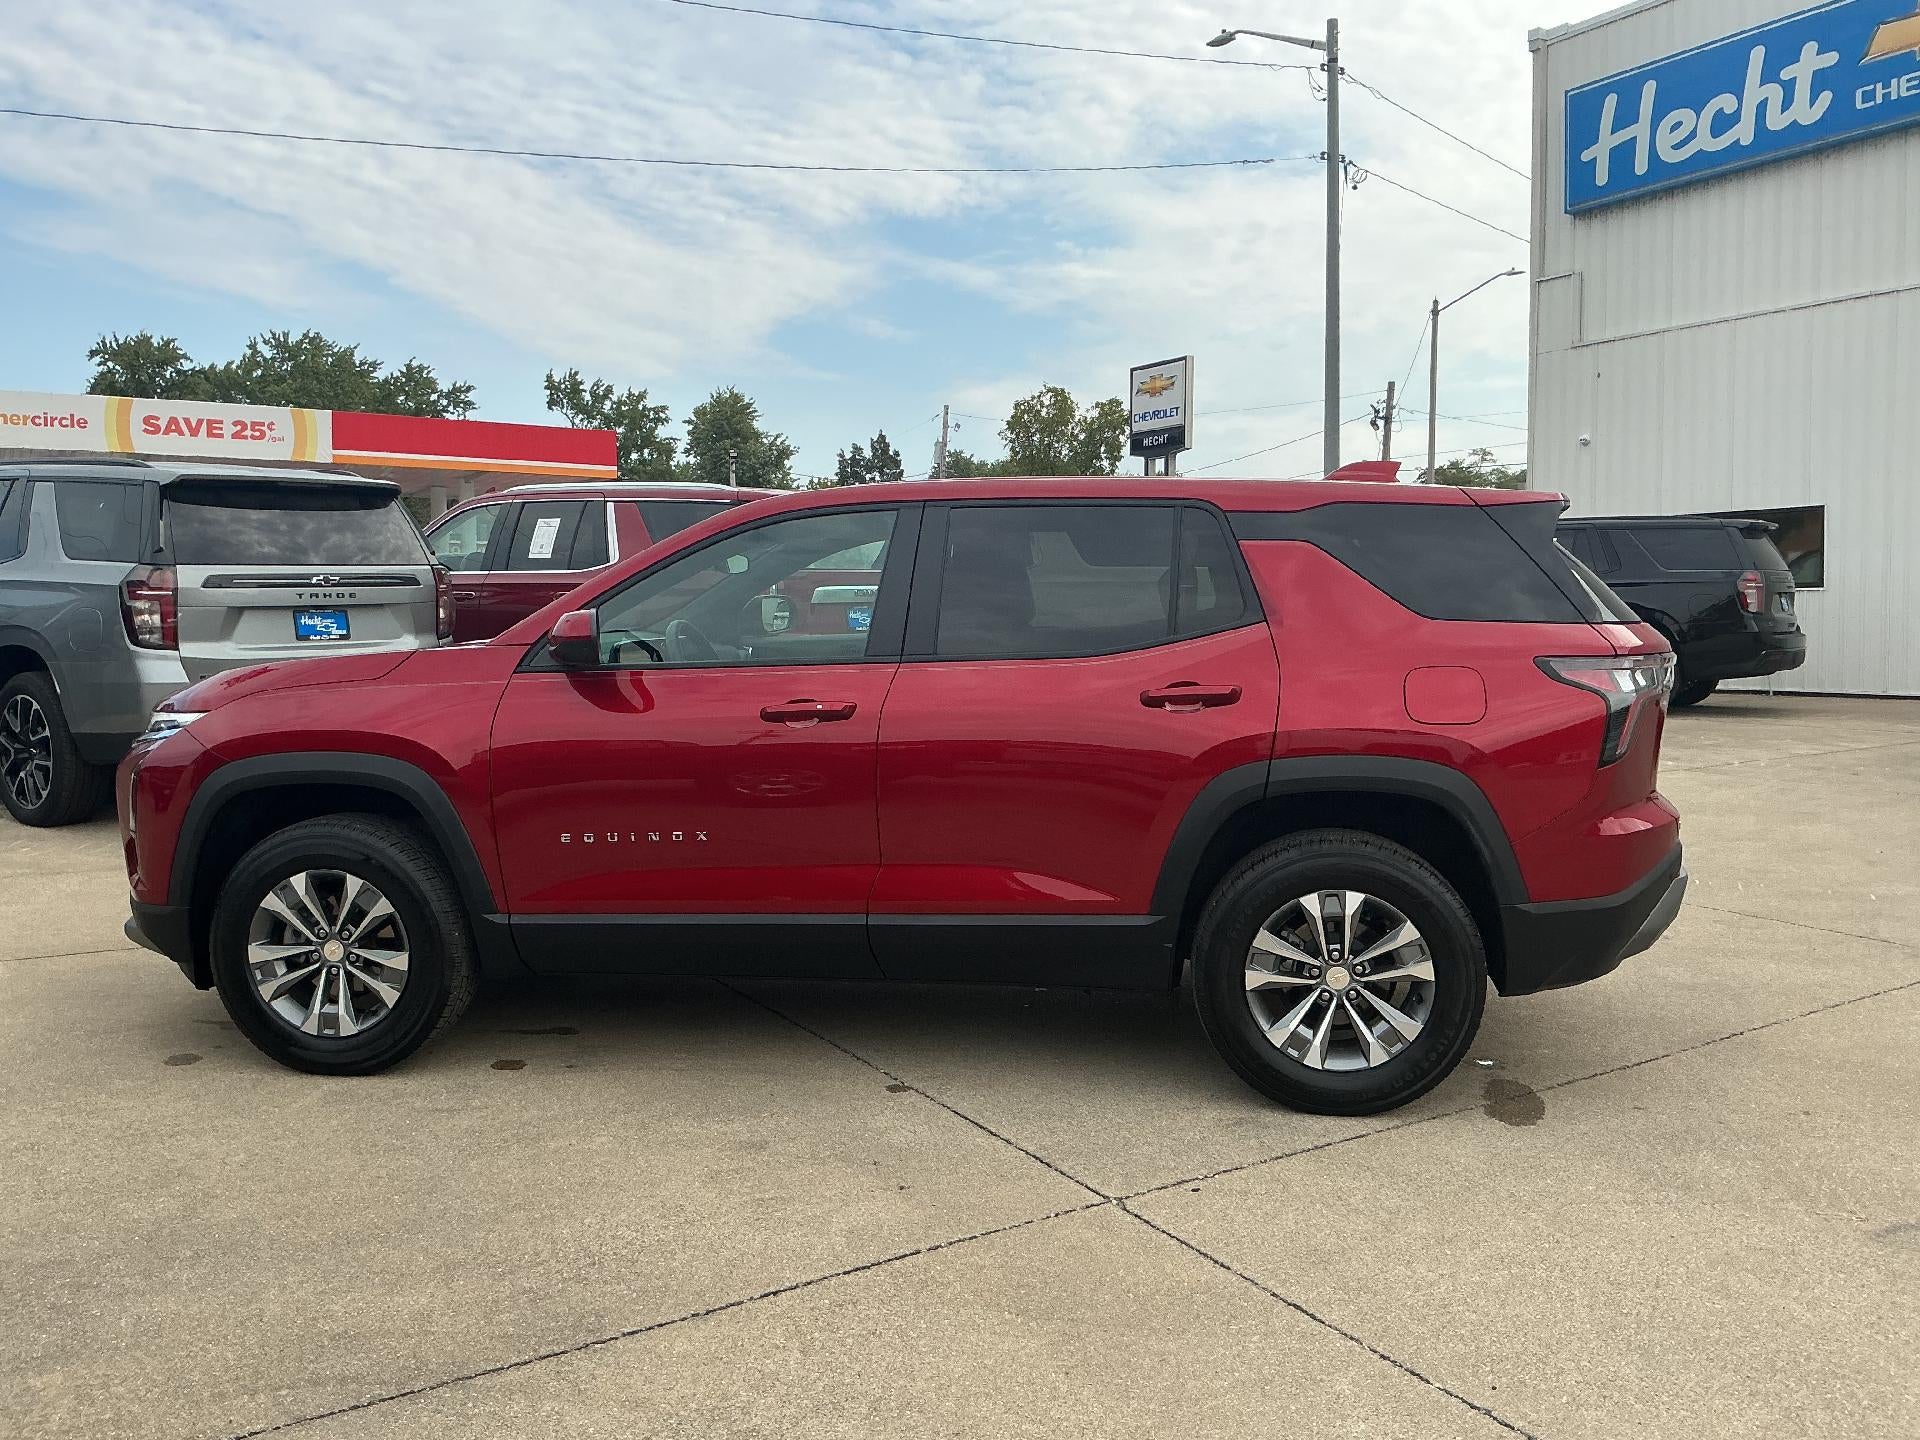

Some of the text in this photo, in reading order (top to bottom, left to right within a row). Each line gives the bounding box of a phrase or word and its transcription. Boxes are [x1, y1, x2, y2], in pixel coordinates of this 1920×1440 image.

[1855, 70, 1920, 110] CHE
[1580, 40, 1840, 187] Hecht
[1133, 406, 1181, 424] CHEVROLET
[142, 414, 225, 440] SAVE
[1143, 433, 1169, 447] HECHT
[295, 592, 357, 600] TAHOE
[560, 830, 708, 844] EQUINOX
